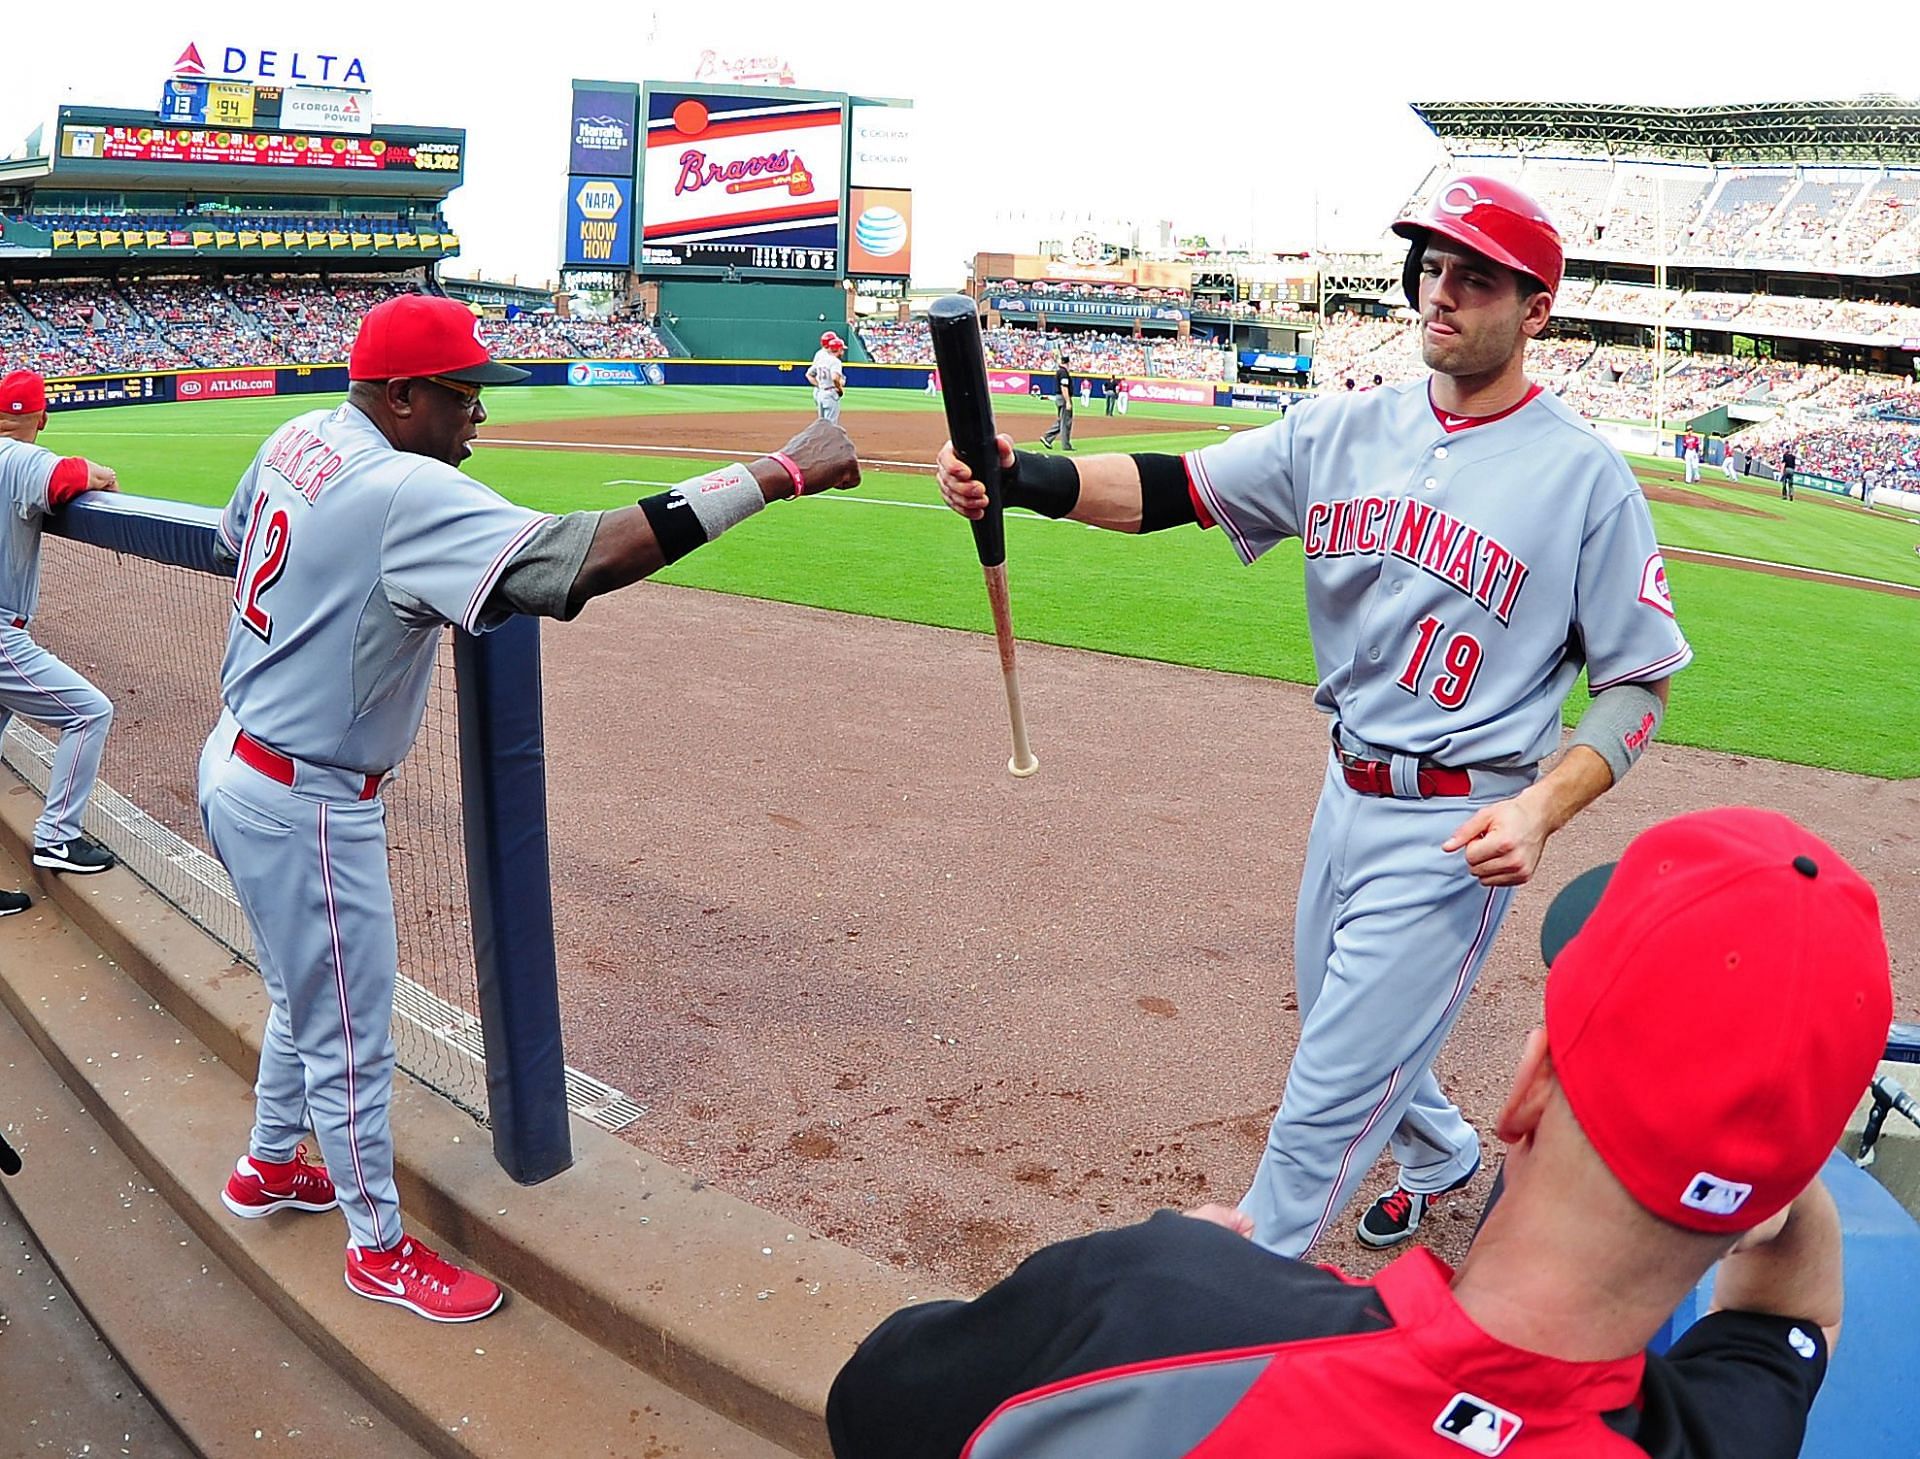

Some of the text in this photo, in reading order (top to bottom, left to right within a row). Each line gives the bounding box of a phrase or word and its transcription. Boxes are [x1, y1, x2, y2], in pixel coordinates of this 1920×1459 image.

[223, 47, 366, 83] DELTA
[292, 102, 340, 113] GEORGIA
[324, 112, 361, 123] POWER
[417, 143, 459, 154] JACKPOT
[675, 149, 789, 196] Braves
[585, 192, 615, 209] NAPA
[1440, 182, 1478, 216] C
[580, 221, 617, 240] KNOW
[583, 240, 612, 259] HOW
[824, 255, 834, 270] 2
[593, 369, 635, 379] TOTAL
[183, 378, 273, 393] KIA ATLKia.com
[233, 490, 294, 646] 12
[1304, 497, 1530, 629] CINCINNATI
[1398, 614, 1484, 712] 19
